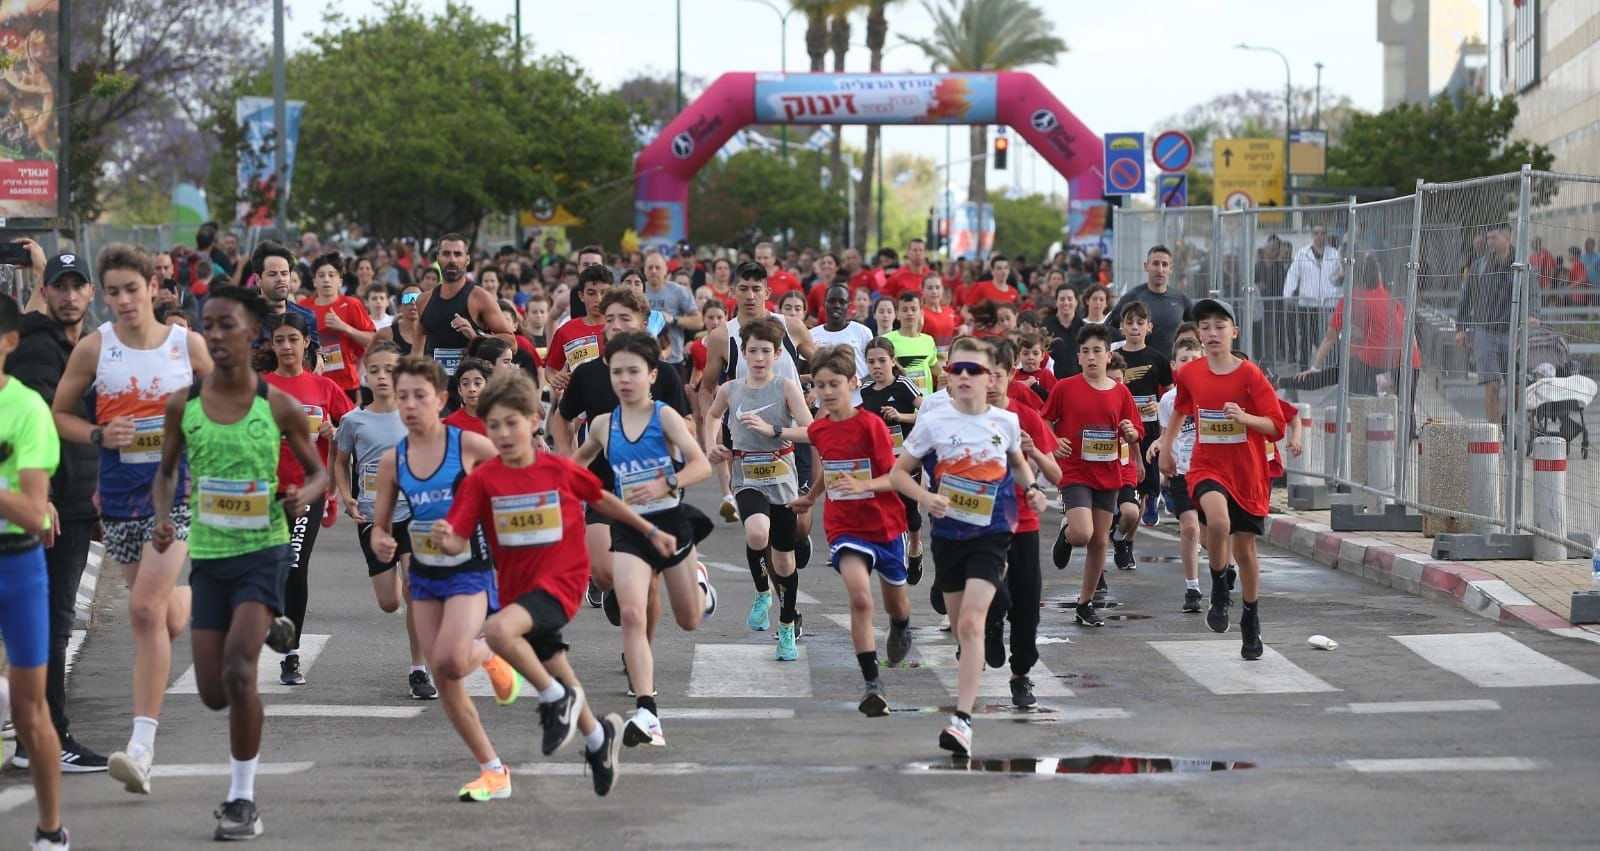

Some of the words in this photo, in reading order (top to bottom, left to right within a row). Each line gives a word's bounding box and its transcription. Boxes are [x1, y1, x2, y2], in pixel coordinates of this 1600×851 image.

[840, 78, 895, 90] הרצליה
[898, 78, 934, 91] מרוץ
[780, 93, 857, 121] זינוק
[1210, 423, 1234, 432] 4183
[136, 434, 162, 448] 418
[1092, 442, 1114, 451] 4202
[752, 465, 777, 475] 4067
[409, 489, 453, 506] MAOZ
[951, 493, 980, 509] 4149
[216, 498, 251, 512] 4073
[510, 512, 544, 528] 4143
